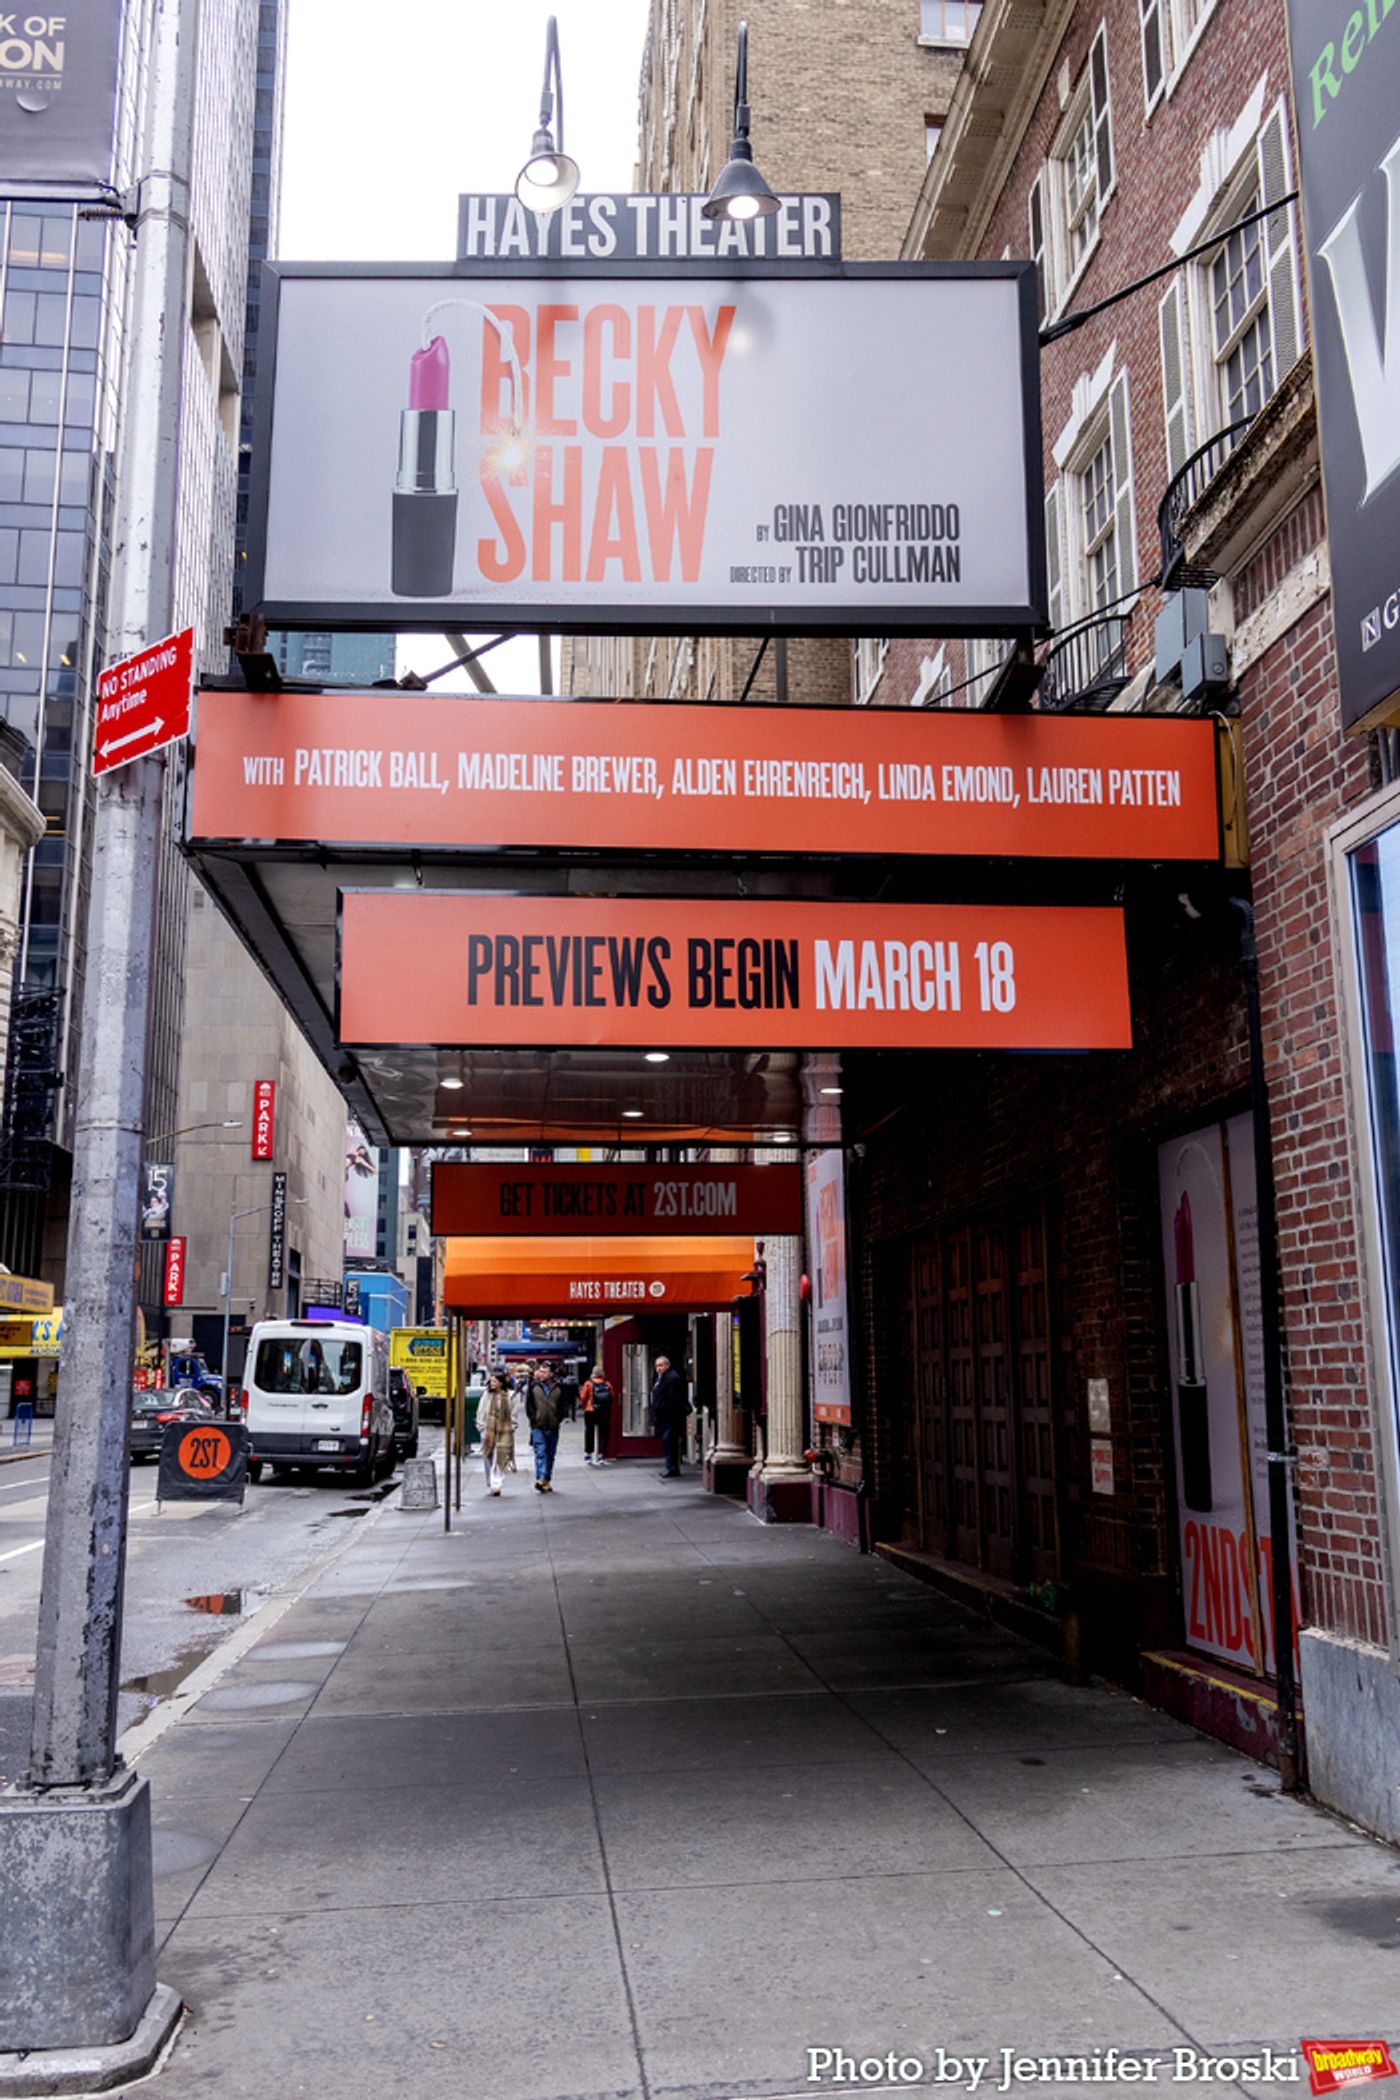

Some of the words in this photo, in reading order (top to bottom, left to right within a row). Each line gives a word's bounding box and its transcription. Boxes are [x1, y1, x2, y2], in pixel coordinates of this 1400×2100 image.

[24, 16, 66, 37] OF
[0, 38, 65, 71] ON
[0, 79, 62, 90] WAY.COM
[466, 196, 617, 257] HAYES
[627, 196, 832, 257] THEATER
[480, 303, 737, 439] BECKY
[477, 445, 715, 583] SHAW
[756, 524, 770, 542] BY
[774, 503, 825, 542] GINA
[832, 503, 961, 543] GIONFRIDDO
[729, 565, 777, 583] DIRECTED
[778, 565, 792, 583] BY
[795, 545, 844, 583] TRIP
[852, 545, 961, 583] CULLMAN
[1383, 588, 1400, 630] G
[101, 676, 119, 699] NO
[120, 646, 178, 691] STANDING
[101, 688, 148, 721] Anytime
[243, 756, 285, 786] WITH
[293, 748, 383, 788] PATRICK
[389, 751, 450, 795] BALL,
[457, 752, 565, 793] MADELINE
[572, 755, 665, 800] BREWER,
[672, 758, 737, 796] ALDEN
[743, 760, 871, 805] EHRENREICH,
[878, 763, 936, 801] LINDA
[942, 765, 1021, 809] EMOND,
[1027, 767, 1102, 805] LAUREN
[1108, 769, 1181, 807] PATTEN
[467, 934, 671, 1009] PREVIEWS
[687, 938, 799, 1009] BEGIN
[814, 939, 961, 1011] MARCH
[973, 941, 1016, 1013] 18
[257, 1099, 270, 1145] PARK
[500, 1182, 535, 1217] GET
[541, 1182, 618, 1217] TICKETS
[624, 1182, 646, 1217] AT
[654, 1182, 737, 1217] 2ST.COM
[168, 1253, 180, 1292] PARK
[569, 1281, 601, 1299] HAYES
[604, 1281, 645, 1299] THEATER
[190, 1437, 221, 1468] 2ST
